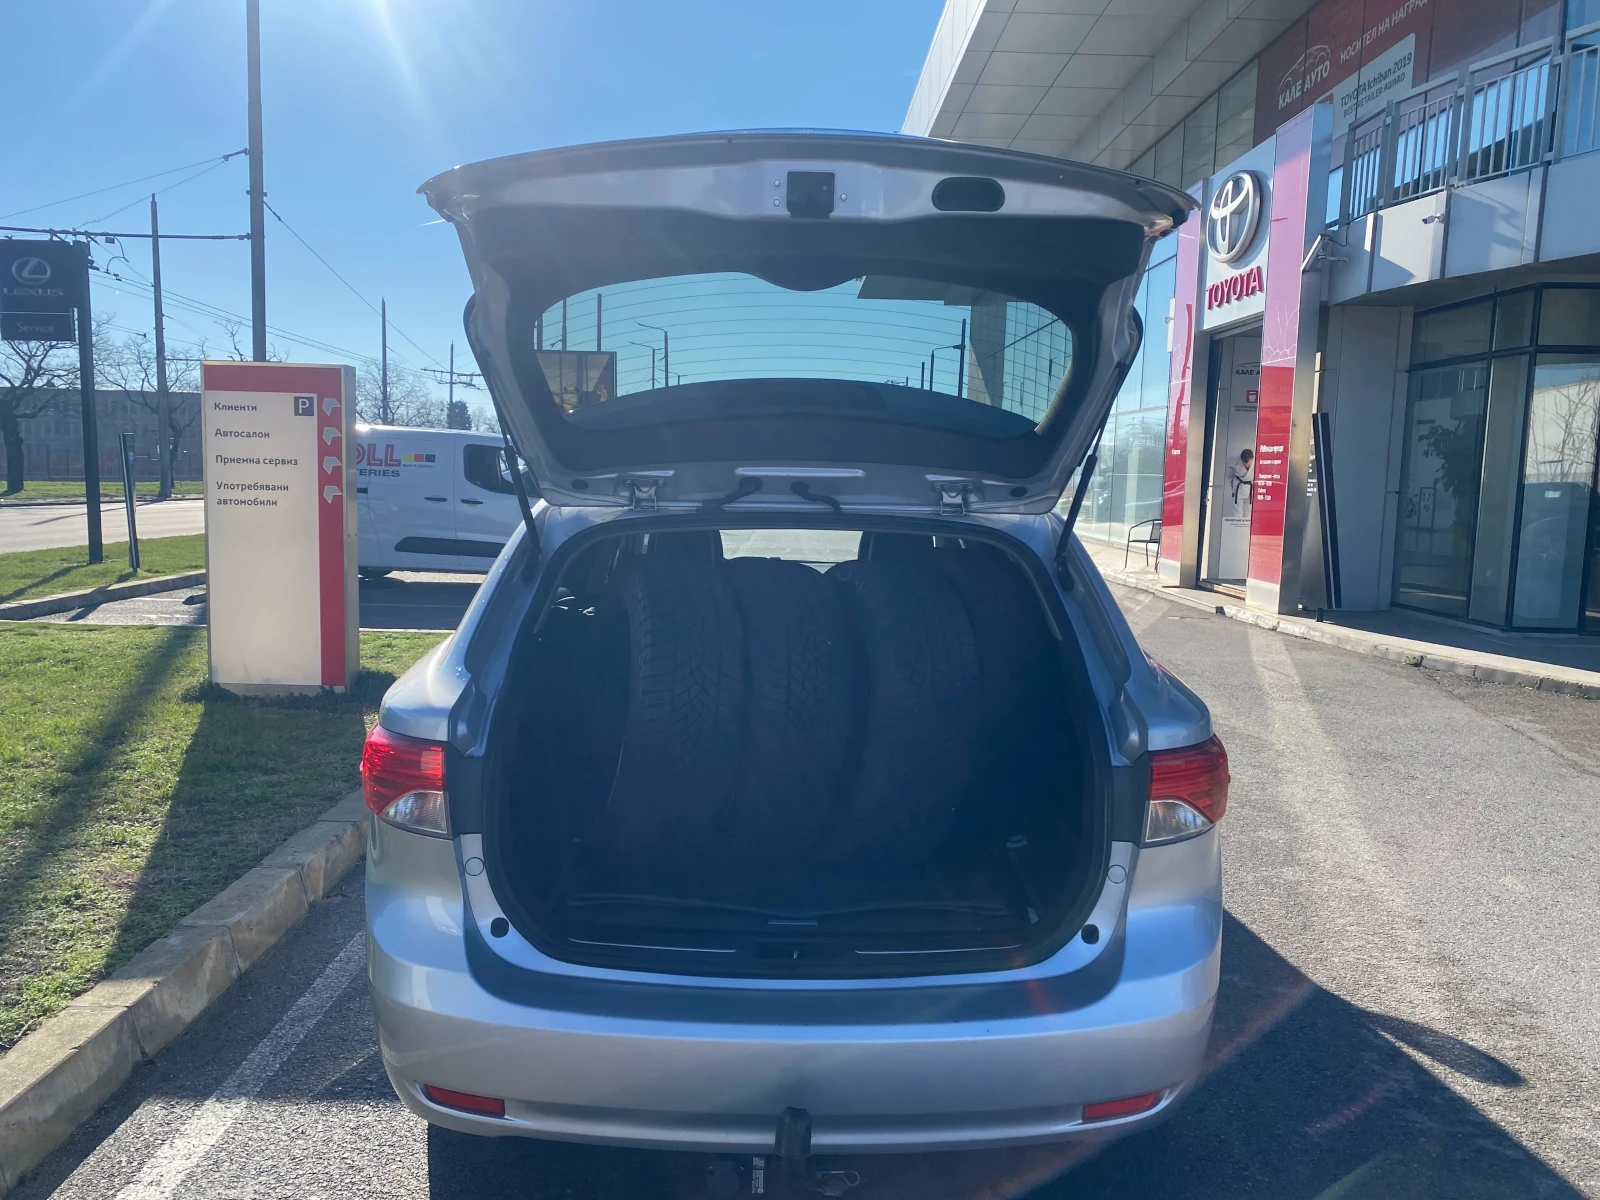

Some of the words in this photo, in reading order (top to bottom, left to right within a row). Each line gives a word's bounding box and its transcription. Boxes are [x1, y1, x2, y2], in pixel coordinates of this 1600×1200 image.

[1340, 30, 1377, 64] НОСИТЕЛ
[1377, 18, 1391, 37] НА
[1278, 80, 1302, 110] КАЛЕ
[1303, 60, 1330, 92] АУТО
[1340, 82, 1367, 108] TOYOTA
[1367, 68, 1392, 89] Ichiban
[1392, 52, 1412, 75] 2019
[1343, 104, 1356, 118] BEST
[1356, 86, 1383, 112] RETAILER
[1383, 72, 1406, 93] AWARD
[3, 287, 64, 296] LEXUS
[1206, 265, 1264, 311] TOYOTA
[17, 321, 55, 333] Service
[214, 402, 258, 412] Клиенти
[214, 428, 270, 439] Автосалон
[215, 454, 261, 466] Приемна
[262, 457, 298, 467] сервиз
[216, 481, 289, 492] Употребявани
[216, 497, 278, 507] автомобили
